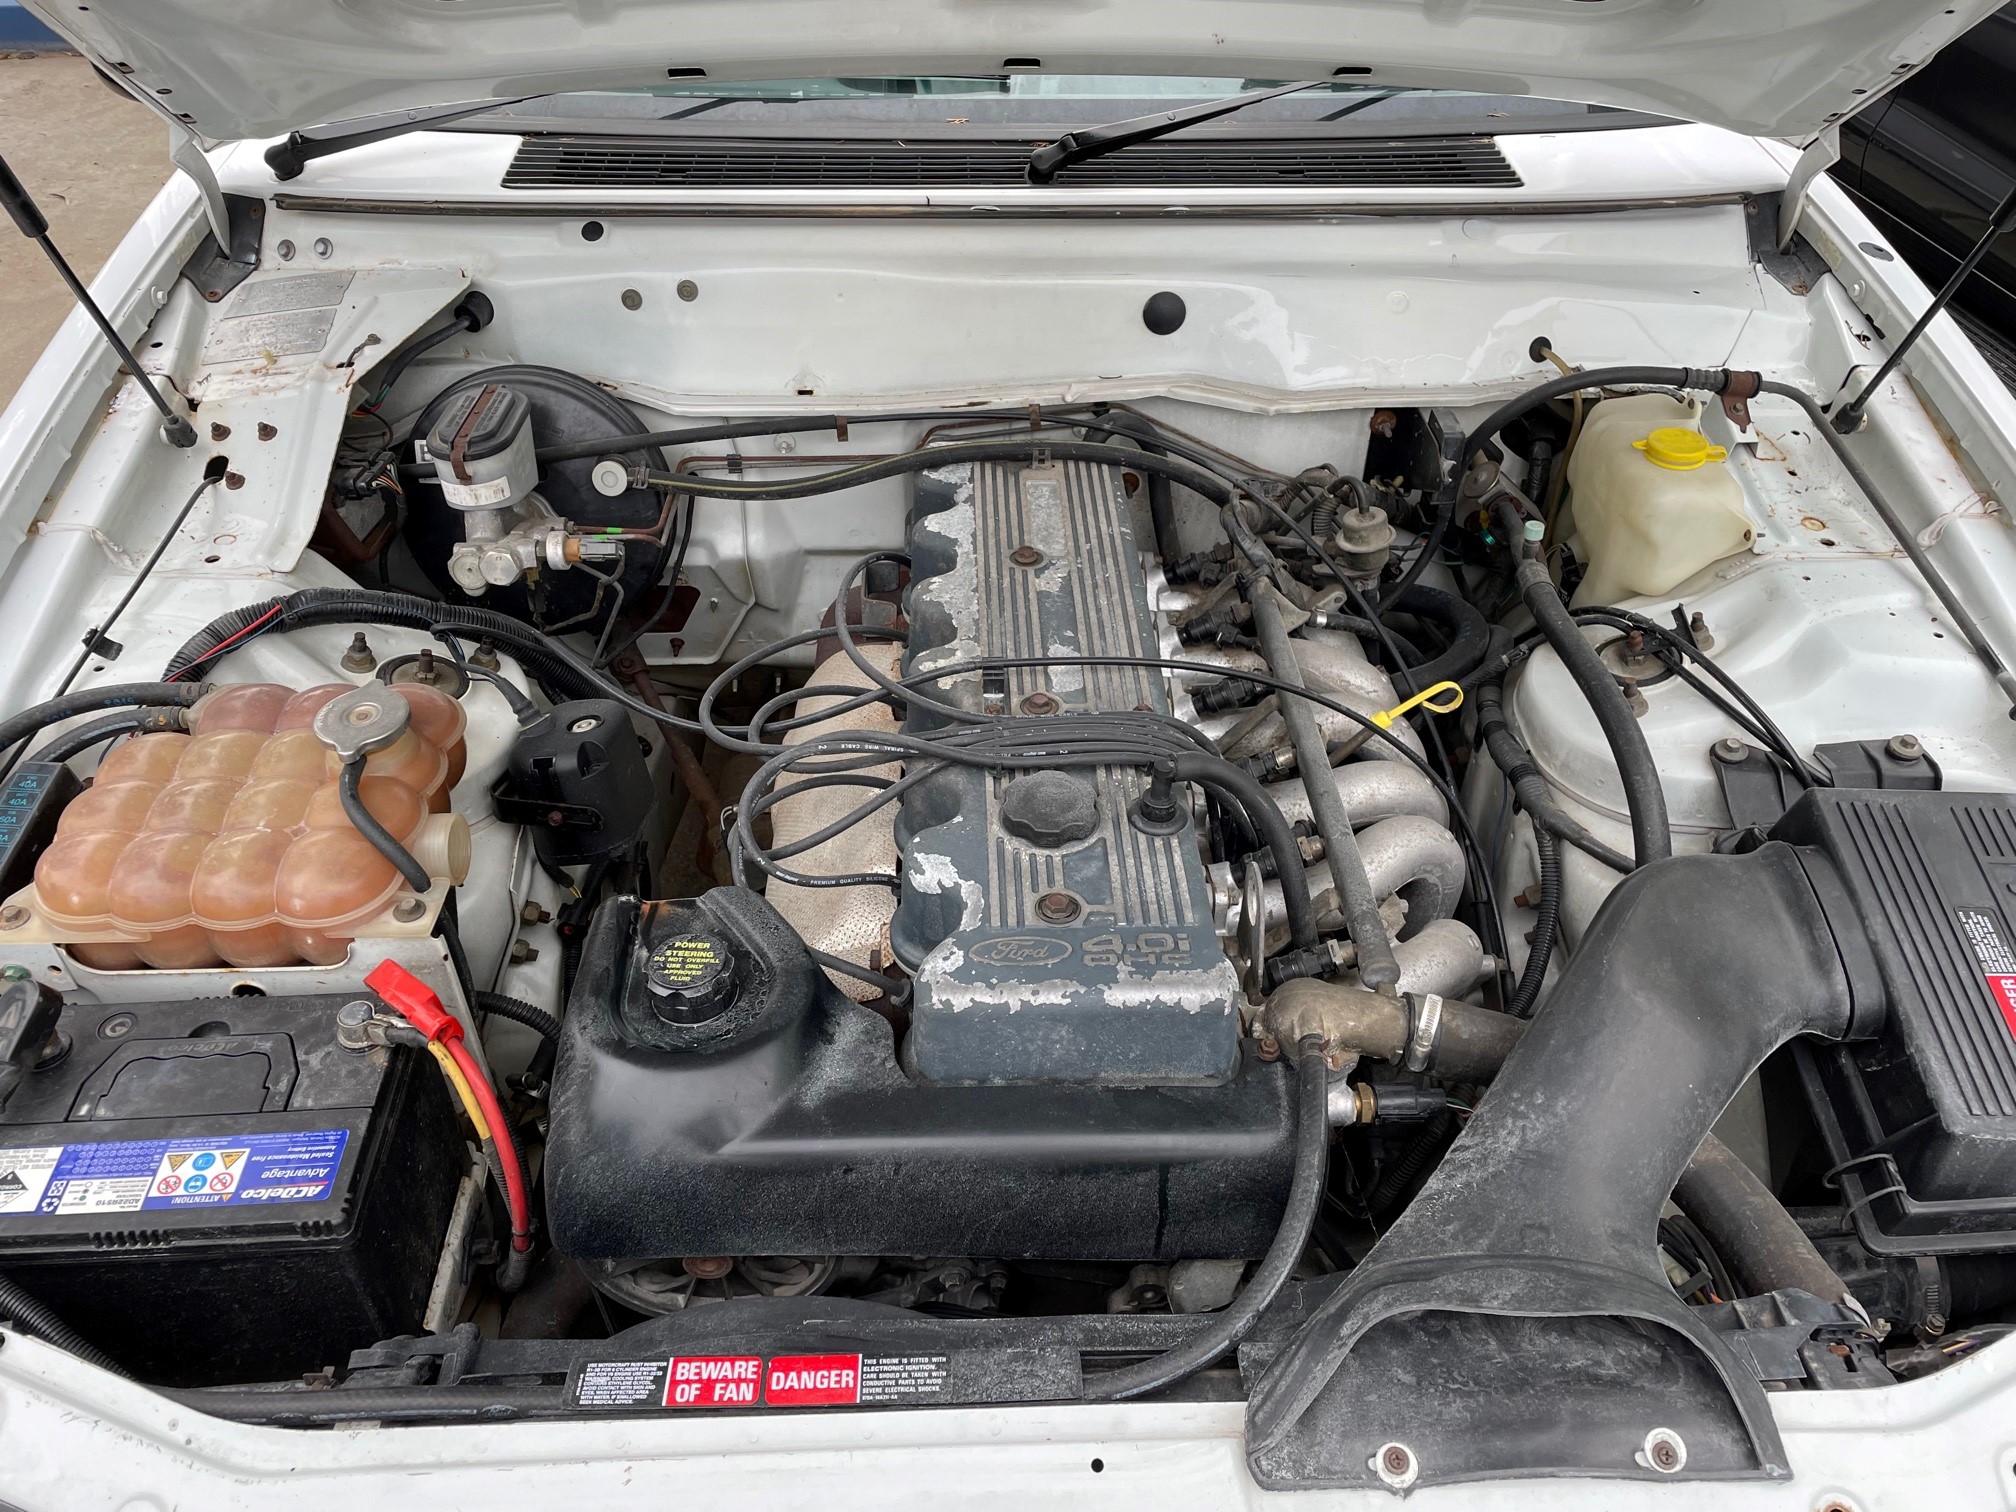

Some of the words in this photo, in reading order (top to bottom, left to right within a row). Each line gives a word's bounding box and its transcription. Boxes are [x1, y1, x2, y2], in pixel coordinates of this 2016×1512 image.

[19, 780, 37, 788] 40A
[665, 950, 714, 958] STEERING
[261, 1167, 330, 1178] Advantage
[171, 1194, 221, 1204] ATTENTION!
[241, 1185, 324, 1200] ACDelco
[676, 1360, 759, 1380] BEWARE
[771, 1369, 854, 1390] DANGER
[676, 1384, 701, 1403] OF
[713, 1383, 754, 1402] FAN
